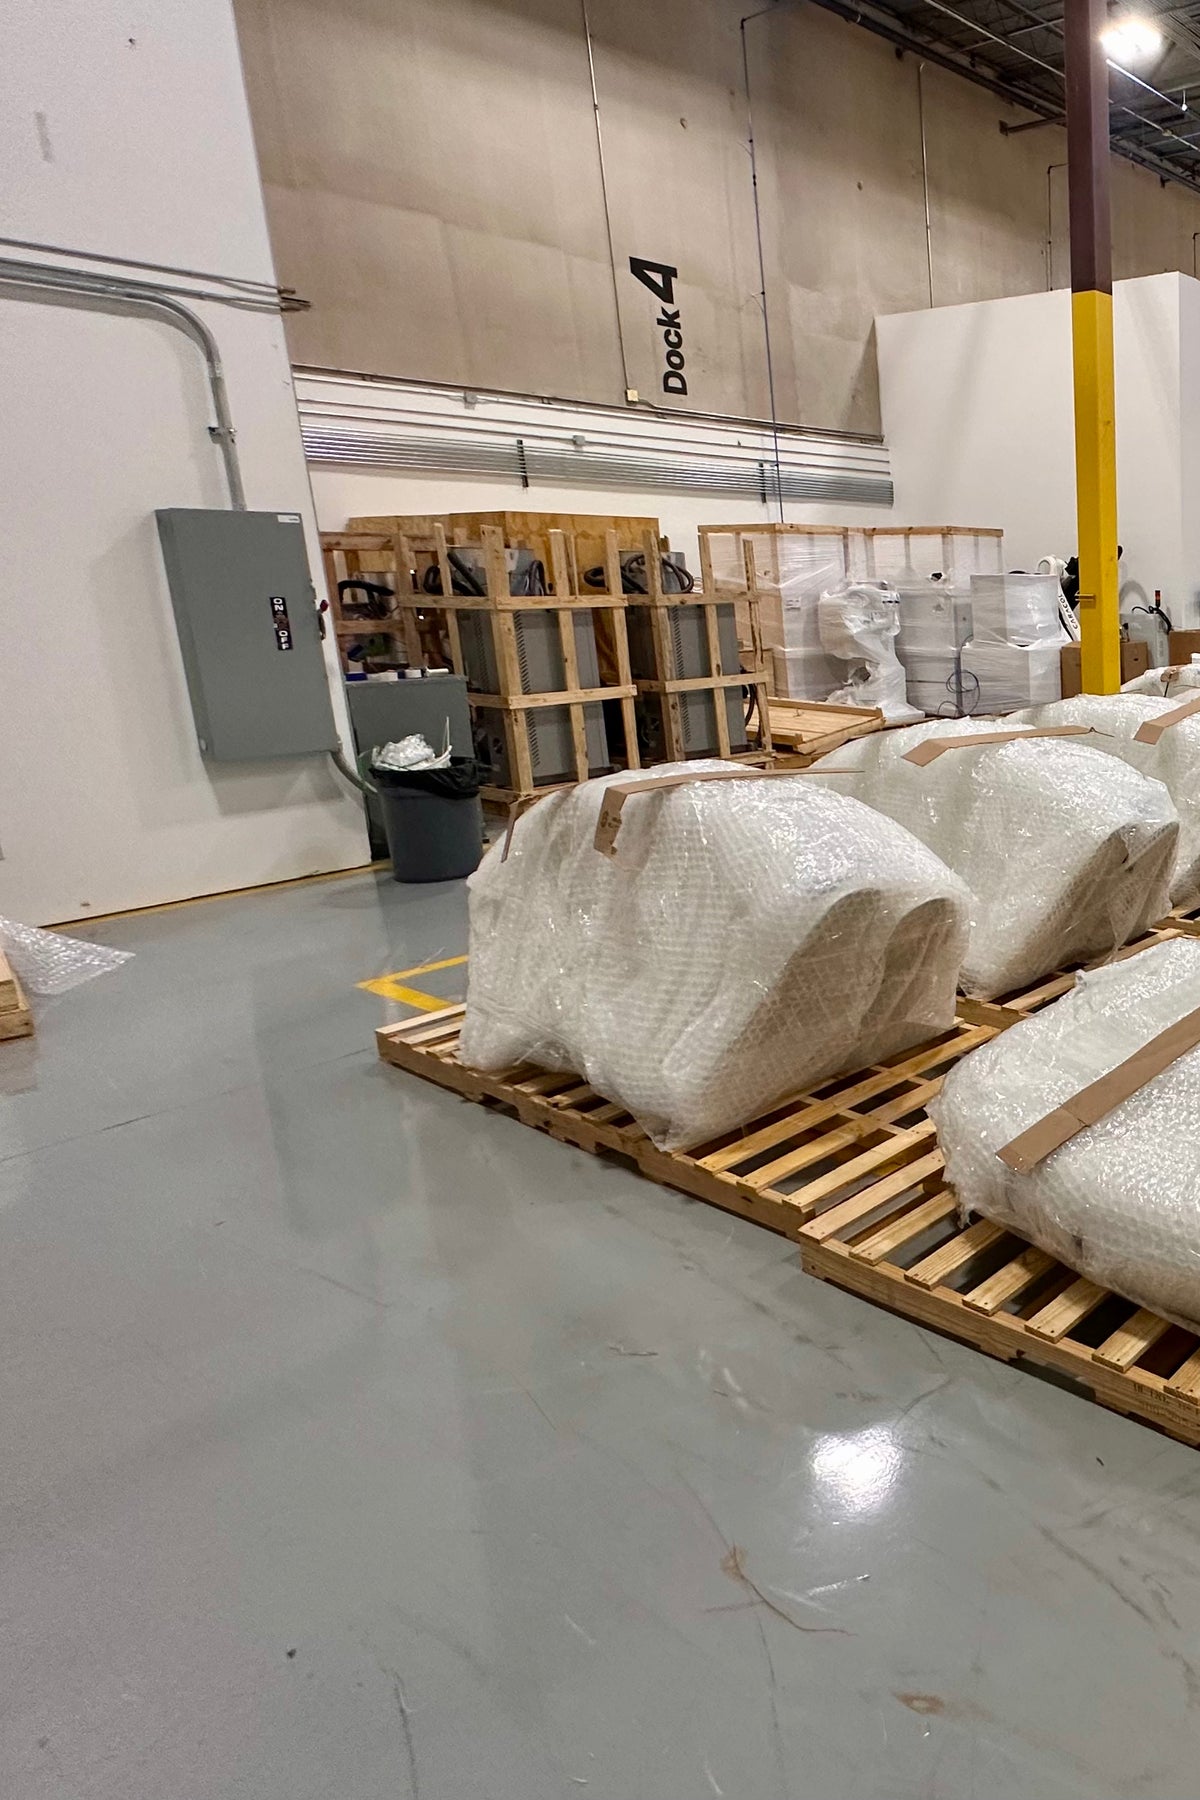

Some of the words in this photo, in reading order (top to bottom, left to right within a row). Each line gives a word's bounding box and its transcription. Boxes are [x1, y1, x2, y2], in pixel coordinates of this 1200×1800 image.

[629, 256, 678, 305] 4
[656, 306, 688, 396] Dock
[273, 598, 284, 611] ON
[1058, 594, 1079, 630] CARACOL
[279, 630, 290, 650] OFF
